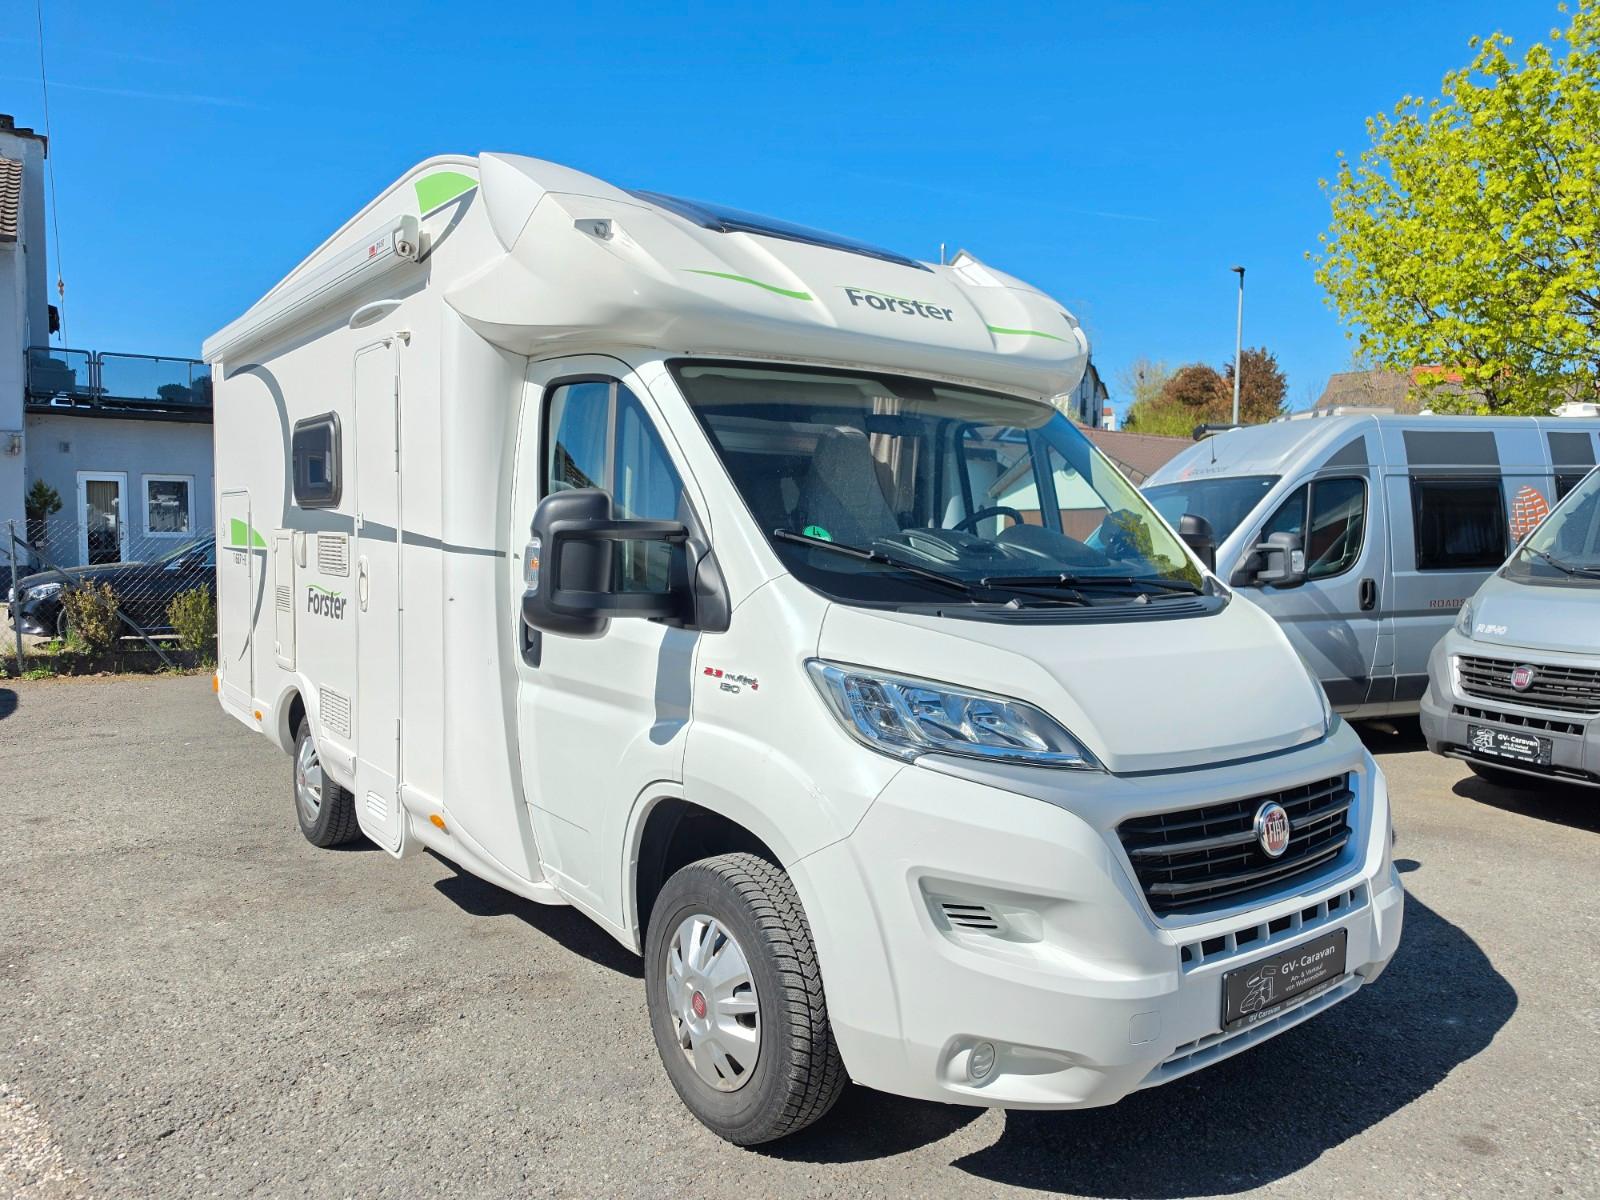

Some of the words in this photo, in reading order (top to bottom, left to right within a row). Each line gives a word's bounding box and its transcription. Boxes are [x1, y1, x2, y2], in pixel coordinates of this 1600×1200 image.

[845, 288, 953, 322] Forster
[812, 526, 821, 537] 4
[307, 587, 347, 620] Forster
[1510, 736, 1538, 747] Caravan
[1267, 819, 1284, 843] FIAT
[1300, 946, 1335, 966] Caravan
[1258, 1006, 1281, 1018] Caravan
